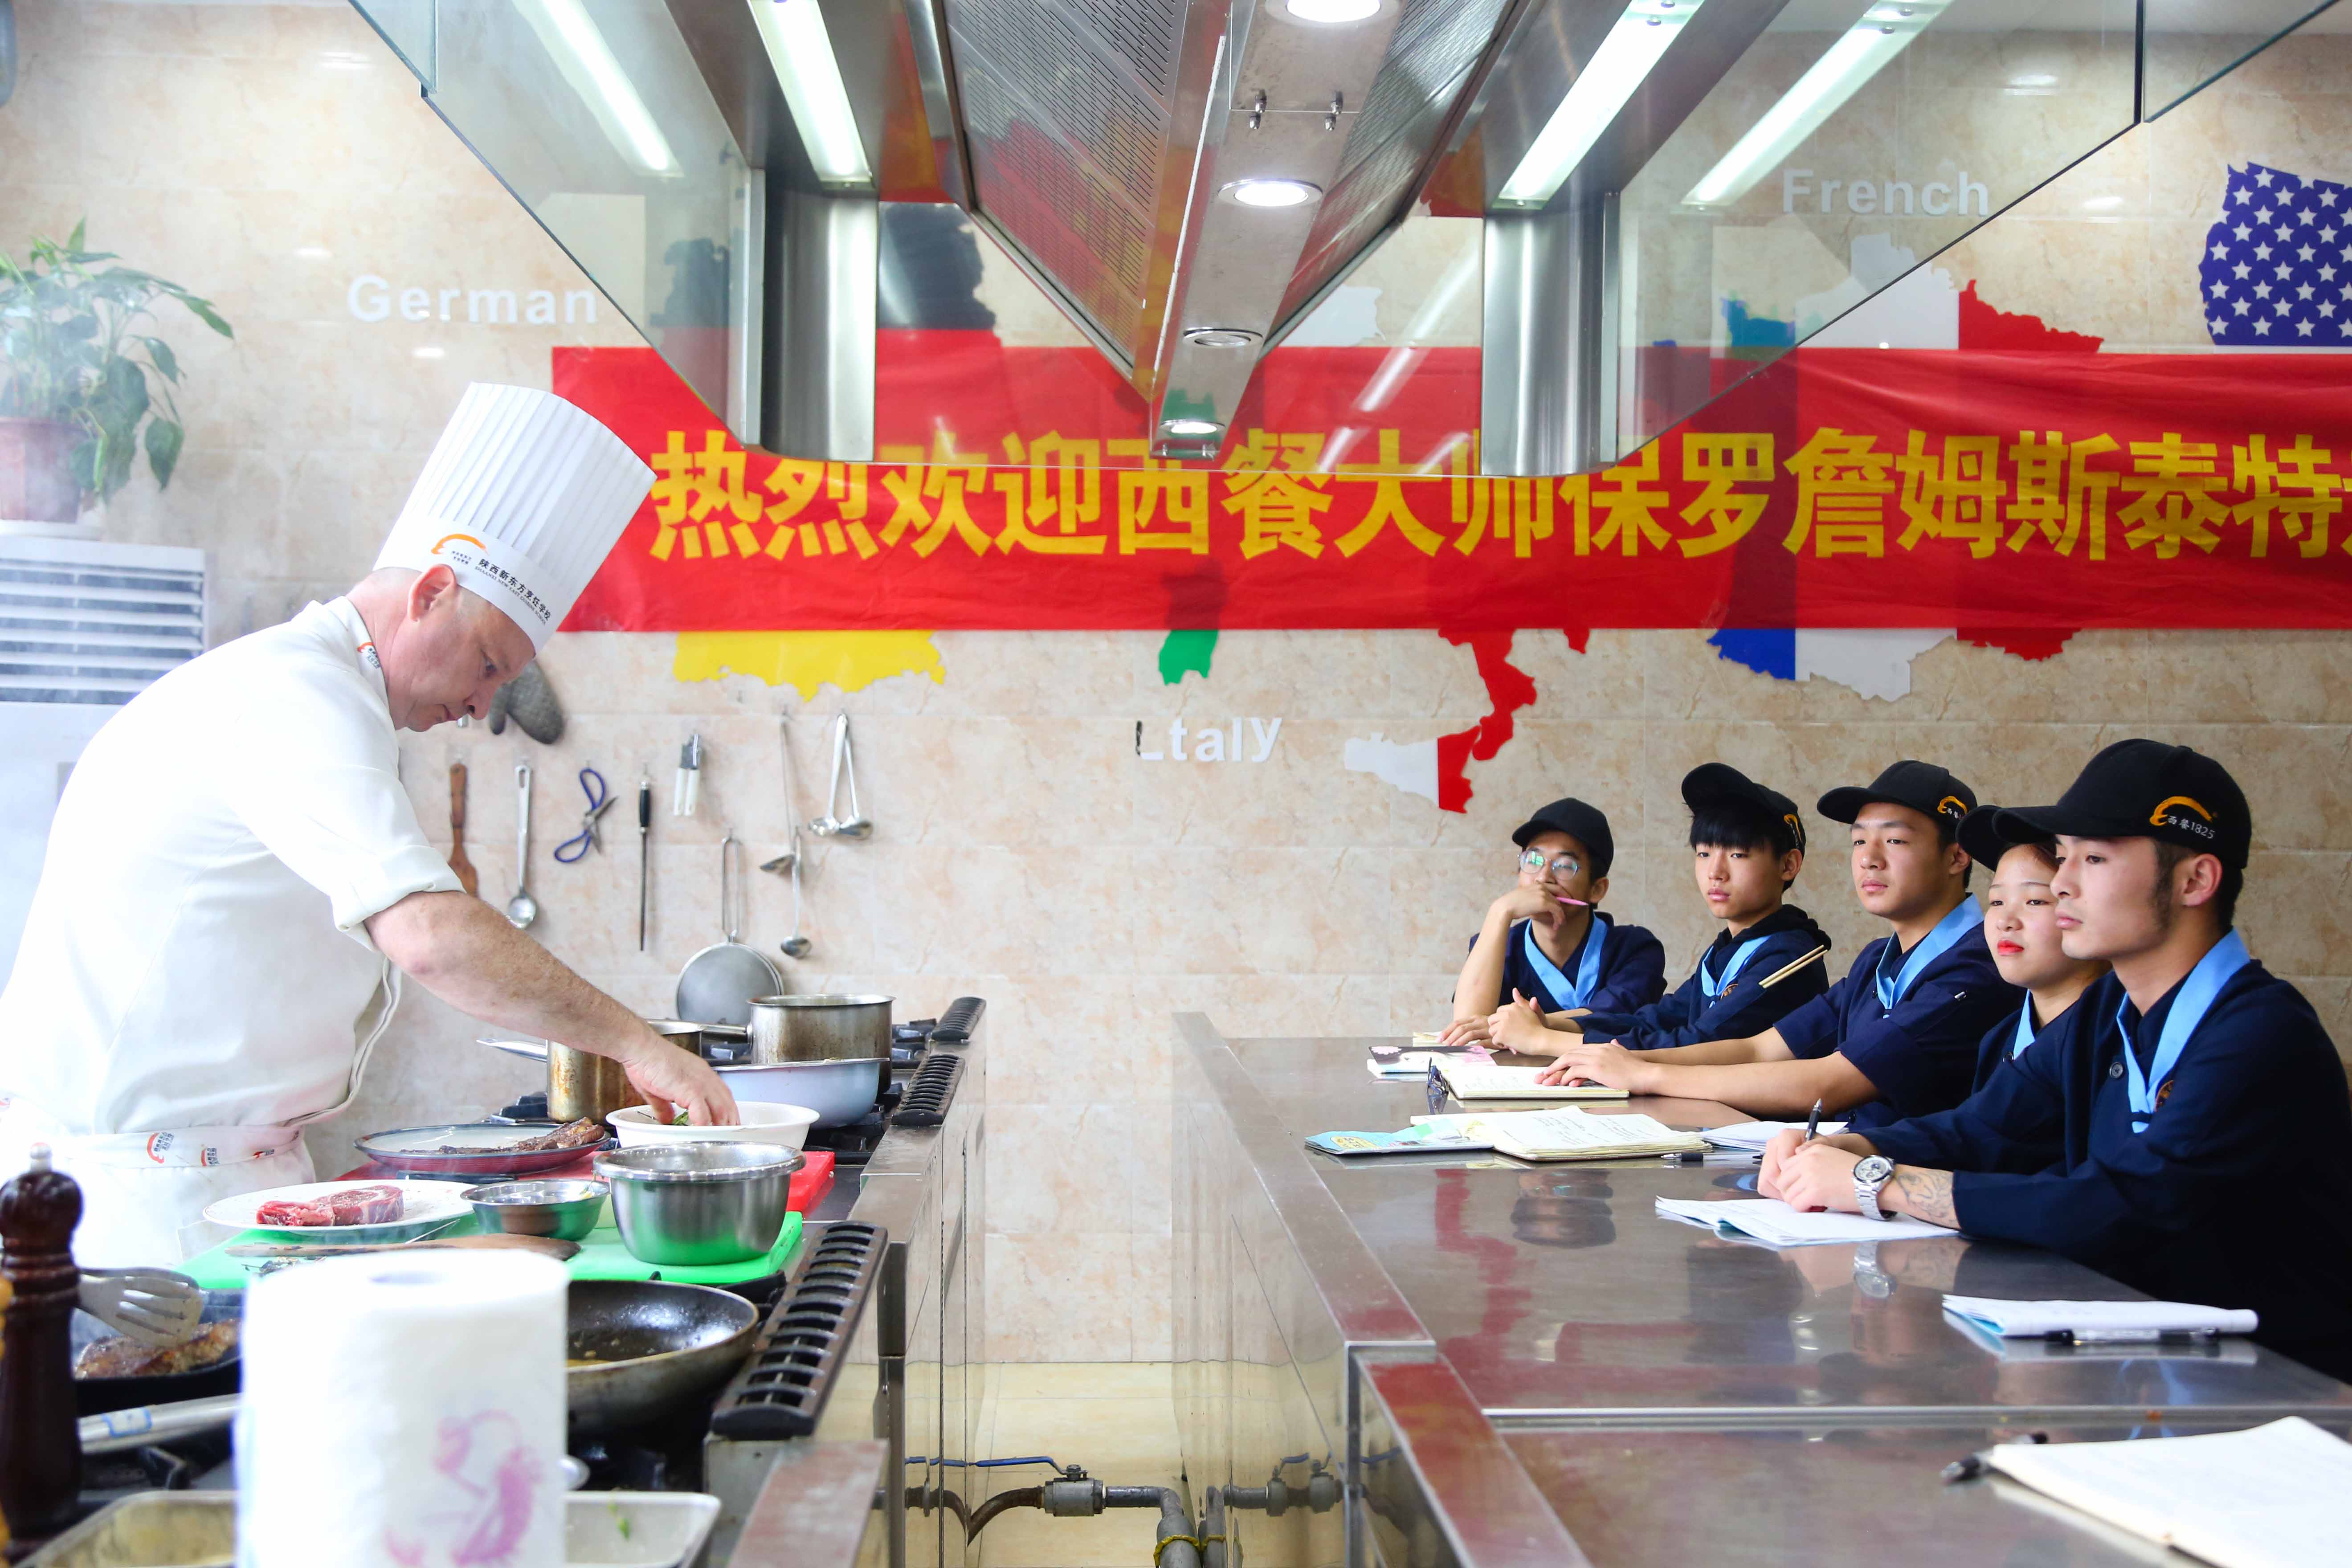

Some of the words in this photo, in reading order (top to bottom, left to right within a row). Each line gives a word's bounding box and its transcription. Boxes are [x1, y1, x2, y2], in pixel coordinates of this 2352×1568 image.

[1782, 168, 1989, 216] French
[347, 274, 598, 325] German
[649, 428, 2352, 559] 热烈欢迎西餐大师保罗詹姆斯泰特
[478, 558, 551, 621] 陕西新东方烹饪学校
